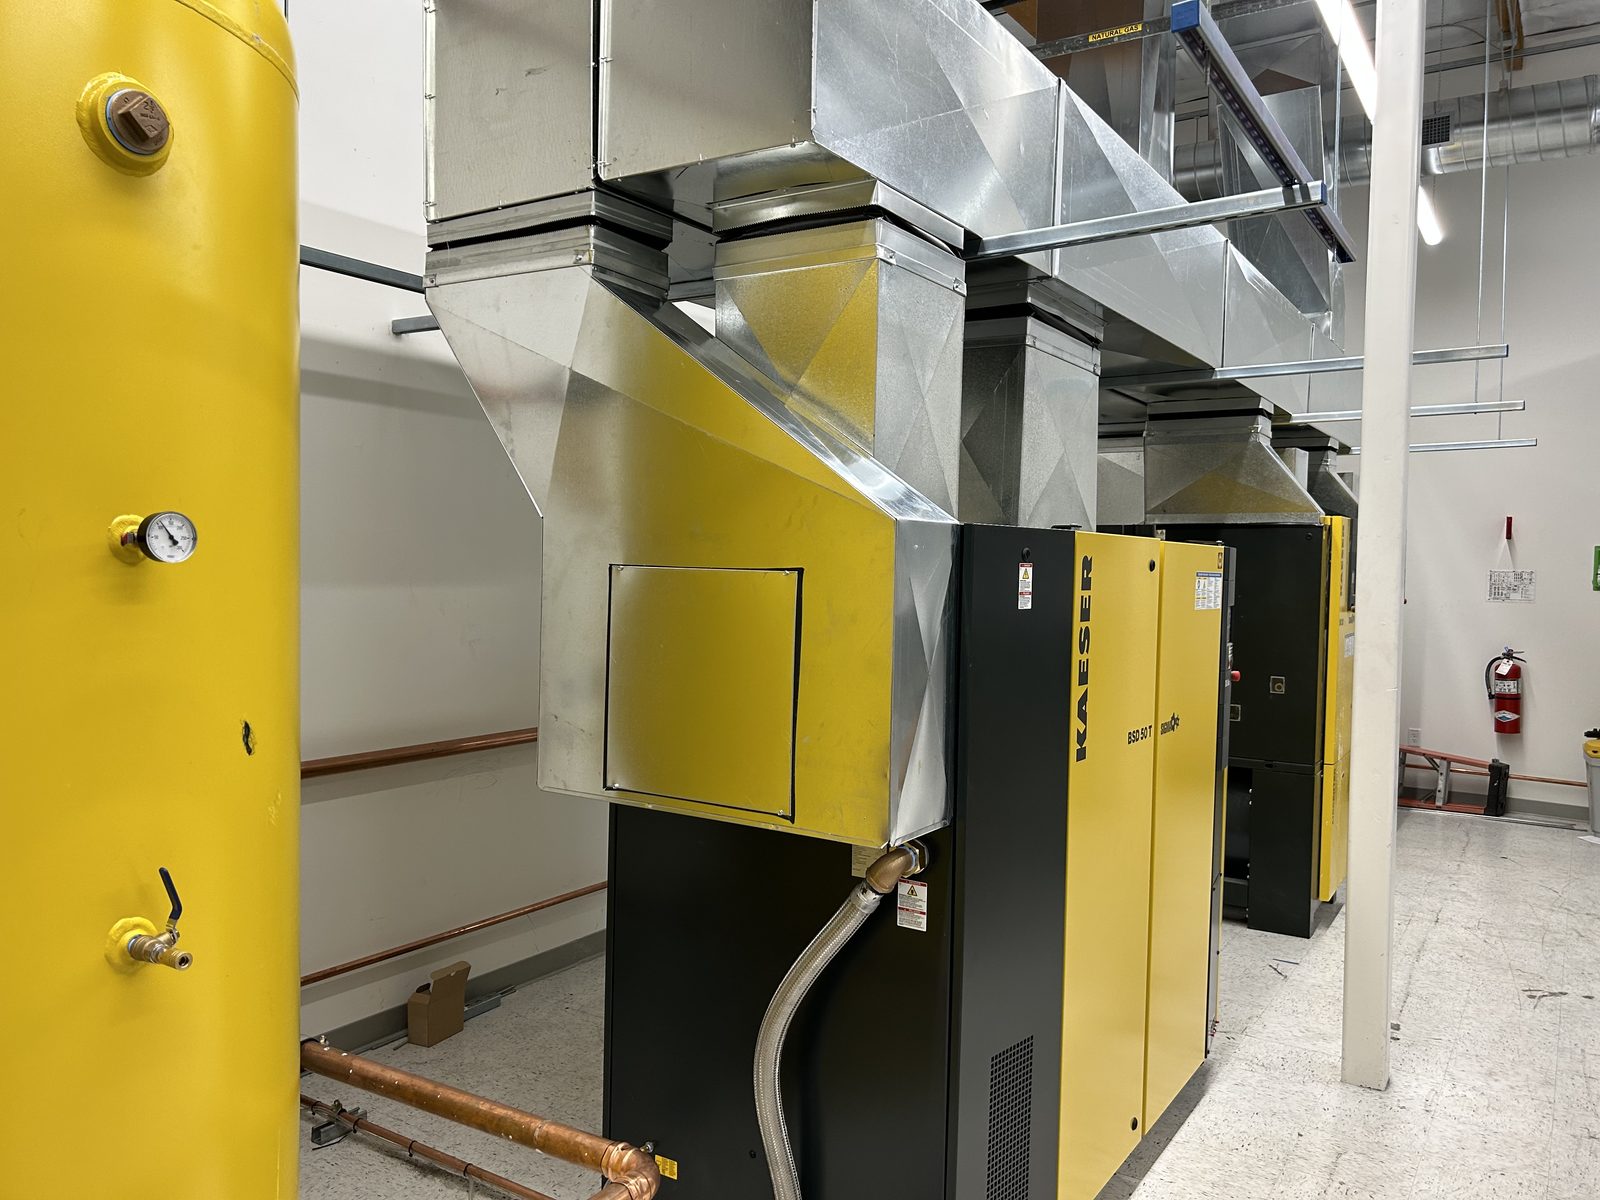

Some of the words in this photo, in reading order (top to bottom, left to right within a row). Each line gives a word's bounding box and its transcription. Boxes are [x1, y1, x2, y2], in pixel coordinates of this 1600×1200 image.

[1092, 29, 1122, 40] NATURAL
[1124, 24, 1139, 33] GAS
[1076, 555, 1093, 762] KAESER
[1127, 729, 1140, 745] BSD
[1140, 726, 1148, 740] 50
[1148, 724, 1153, 738] T
